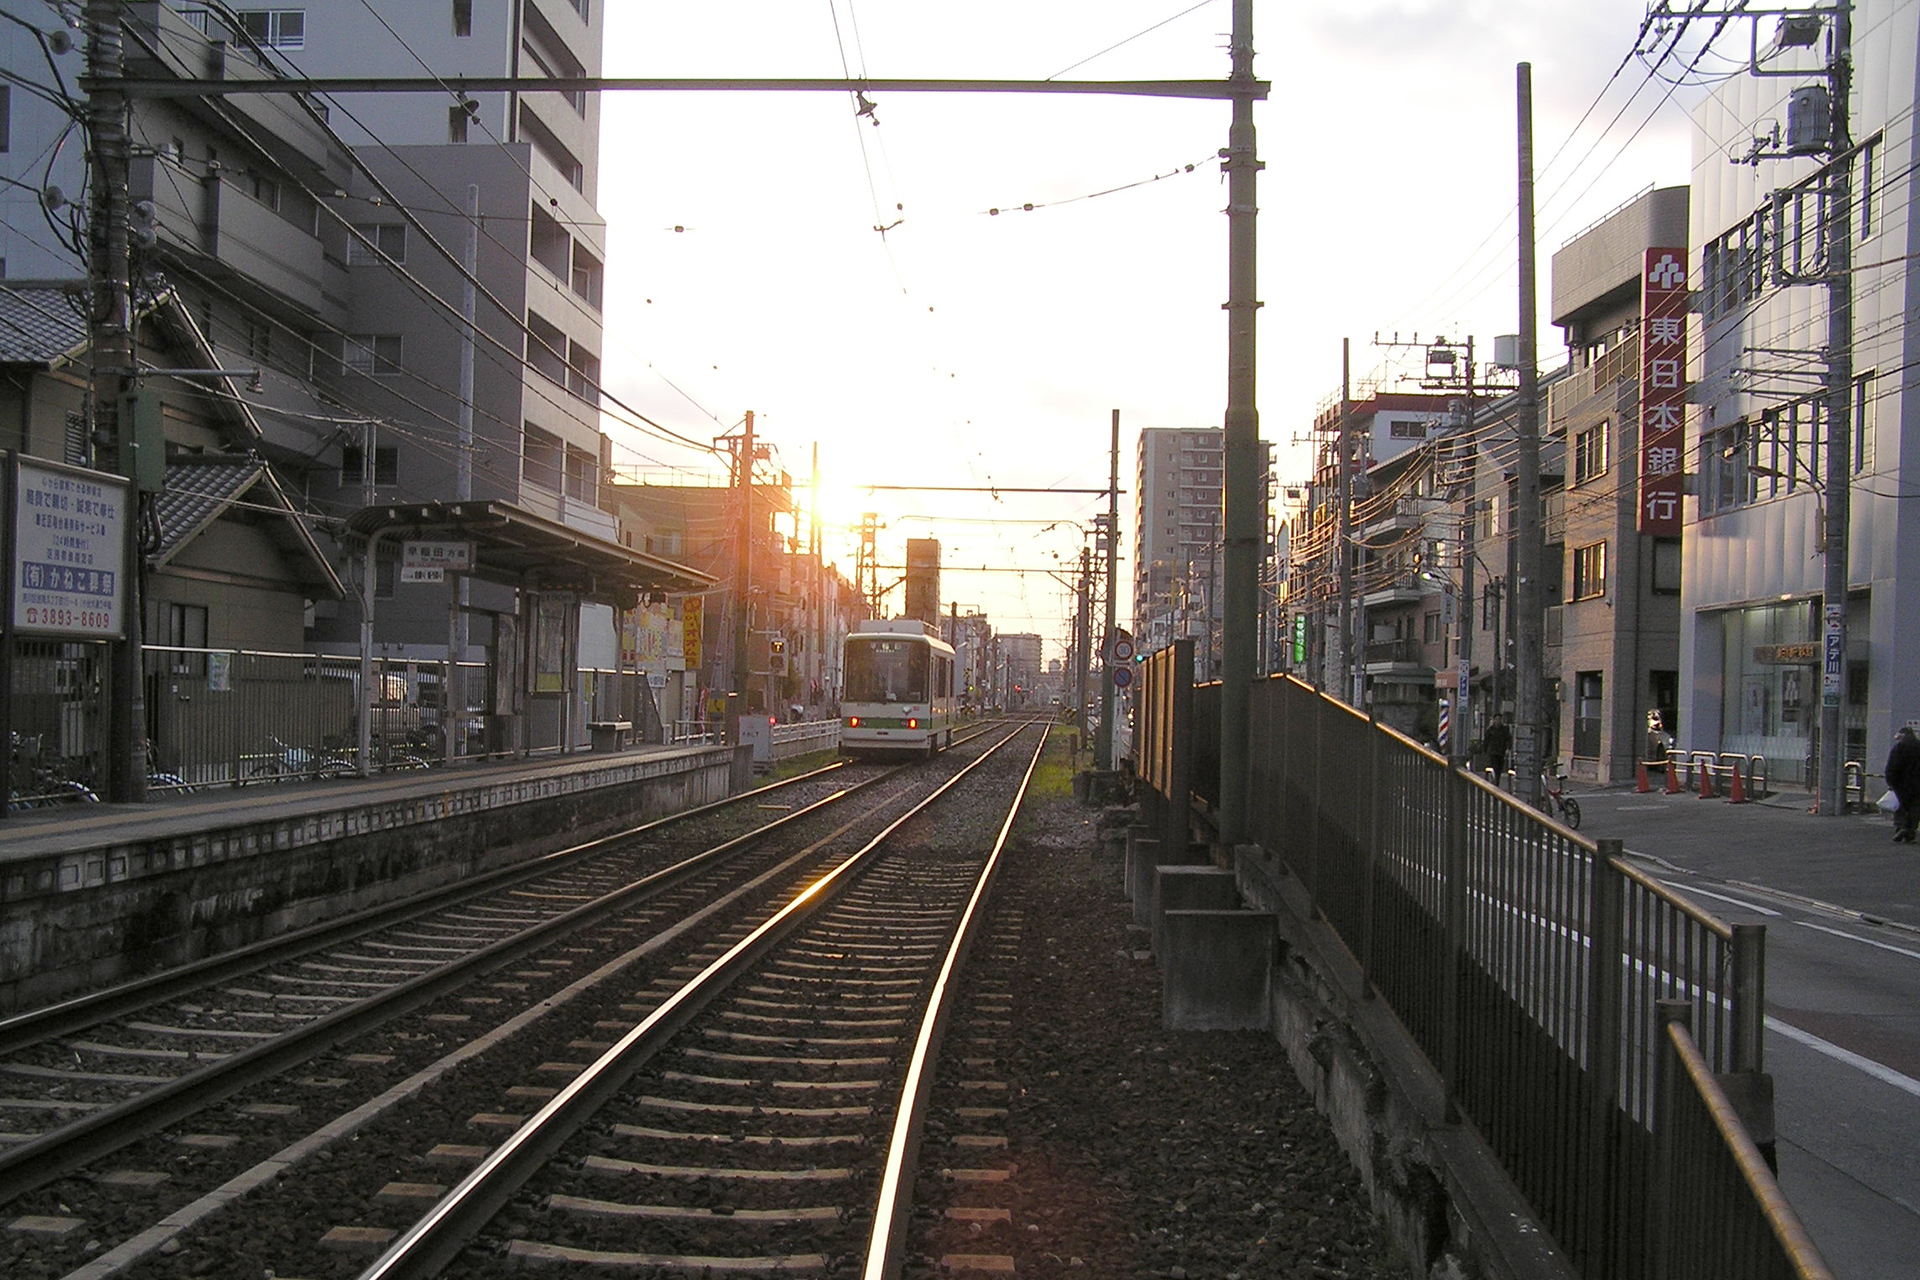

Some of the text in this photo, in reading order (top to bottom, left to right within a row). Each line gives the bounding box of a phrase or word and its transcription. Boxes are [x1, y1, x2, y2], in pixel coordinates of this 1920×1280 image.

[1646, 316, 1680, 520] 東日本銀行
[42, 607, 109, 628] 3893-8609
